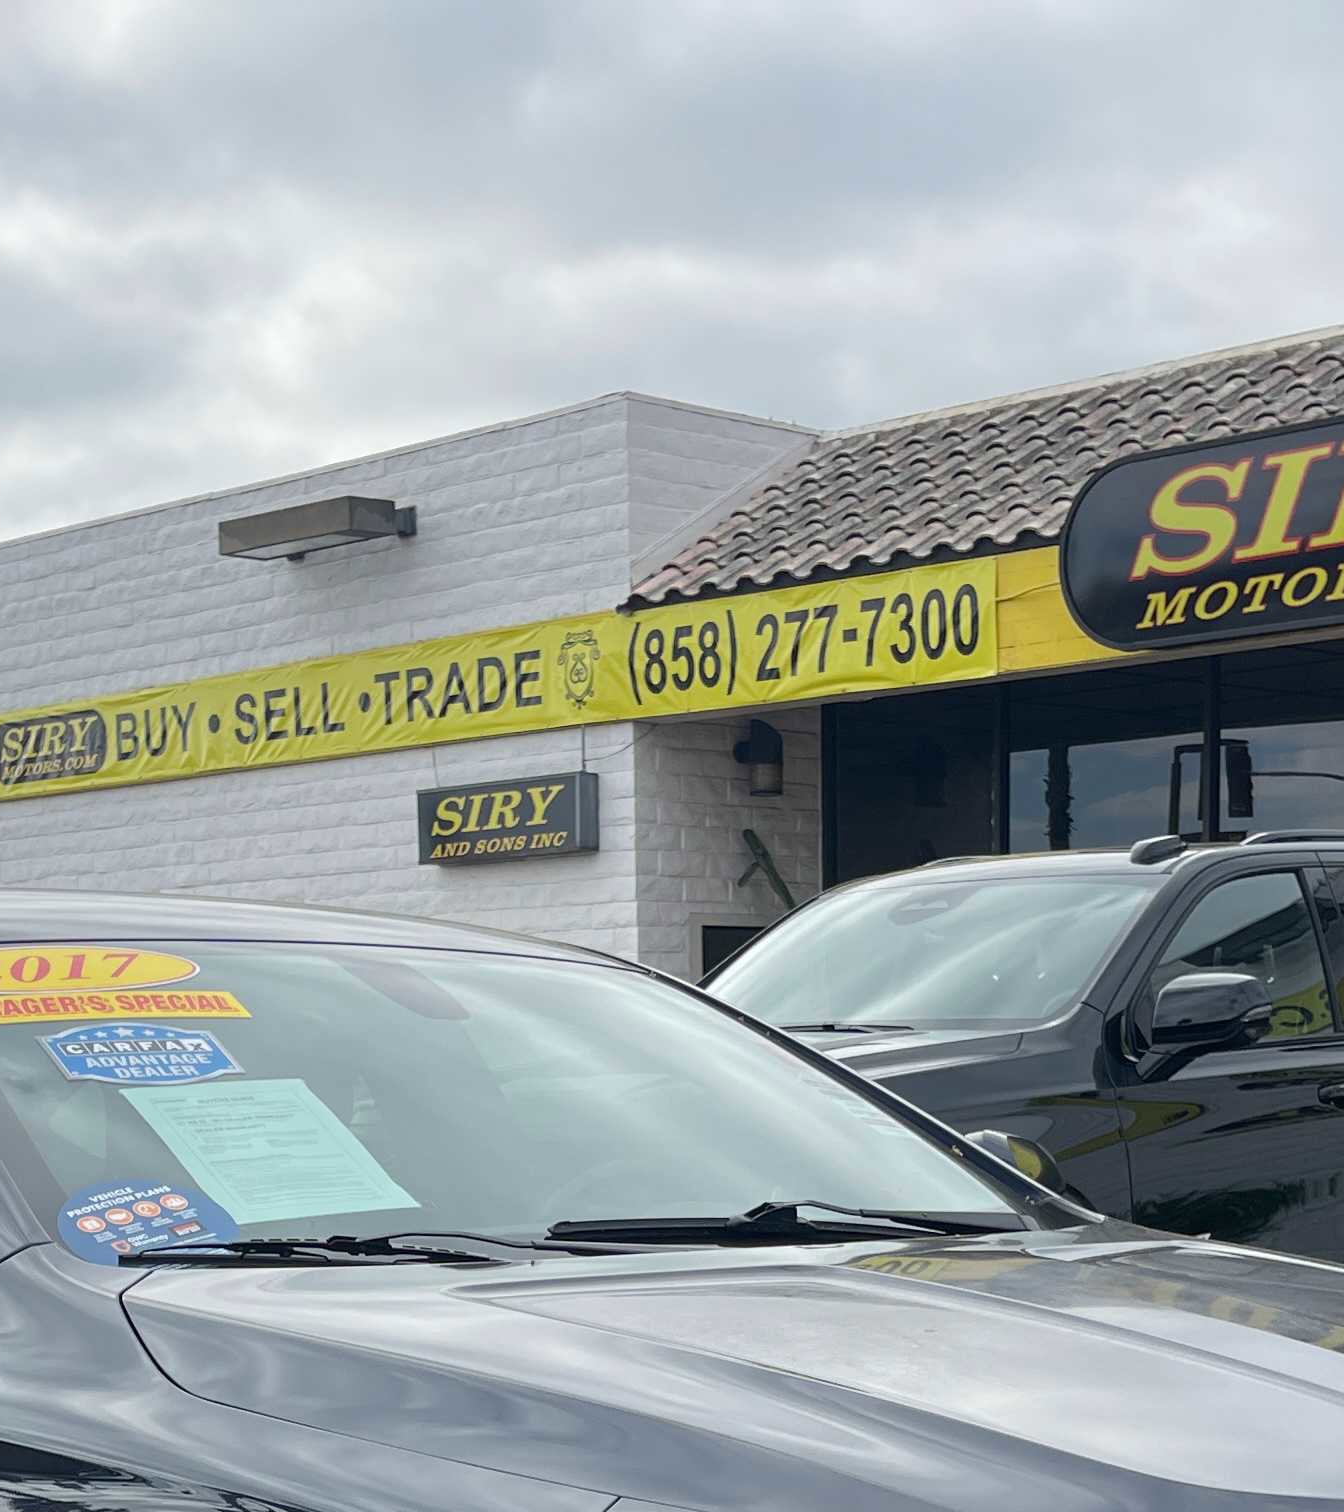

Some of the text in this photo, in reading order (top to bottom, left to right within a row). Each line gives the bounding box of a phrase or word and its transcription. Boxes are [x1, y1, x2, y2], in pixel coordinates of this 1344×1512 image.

[627, 583, 980, 706] (858) 277-7300
[115, 650, 542, 762] BUY SELL TRADE
[0, 714, 100, 764] SIRY
[0, 752, 100, 783] MOTORS.COM
[431, 784, 565, 837] SIRY
[430, 831, 568, 859] AND SONS INC
[115, 993, 238, 1014] SPECIAL
[60, 1038, 213, 1056] CARFAX
[85, 1053, 212, 1069] ADVANTAGE
[114, 1066, 200, 1079] DEALER
[66, 1184, 173, 1218] PROTECTION PLANS
[88, 1186, 136, 1203] VEHICLE
